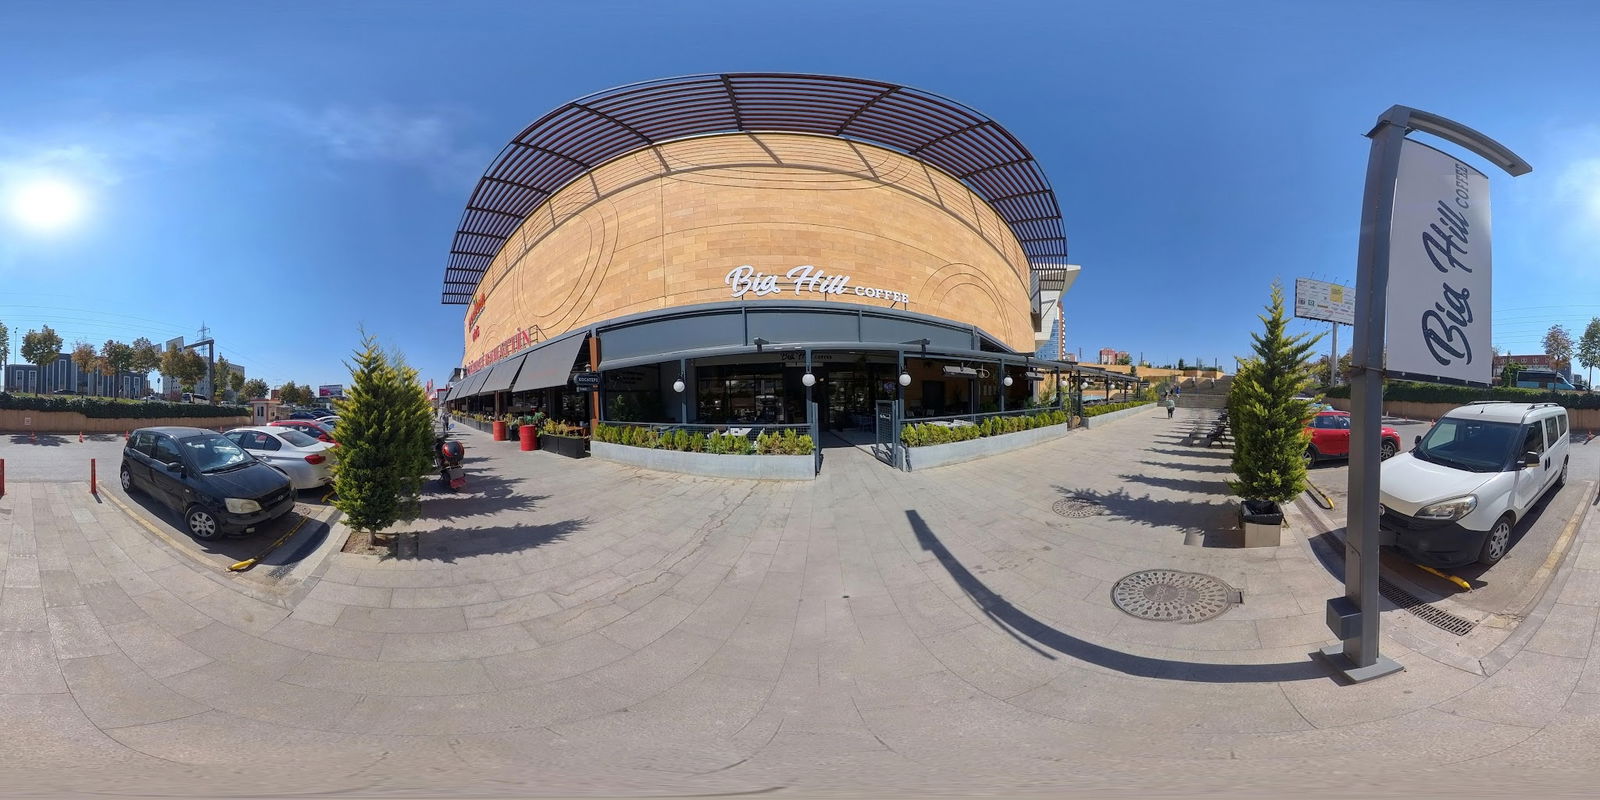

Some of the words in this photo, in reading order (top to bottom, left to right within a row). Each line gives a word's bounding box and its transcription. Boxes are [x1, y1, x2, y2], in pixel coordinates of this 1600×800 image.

[1455, 163, 1469, 209] COFFEE
[1422, 200, 1473, 274] Hill
[724, 264, 781, 298] Big
[786, 264, 850, 296] Hill
[854, 285, 909, 304] COFFEE
[1422, 282, 1473, 366] Big
